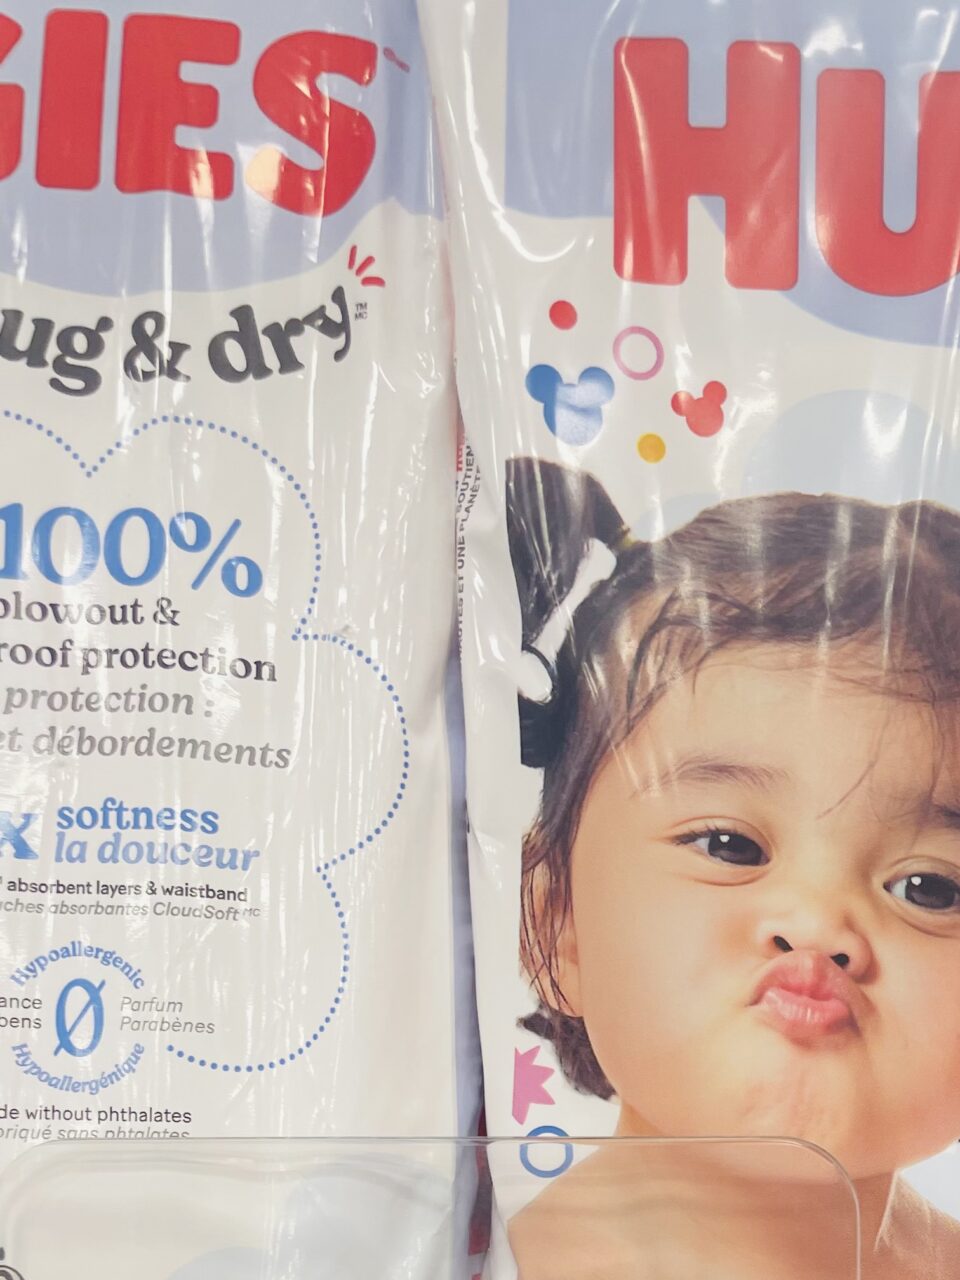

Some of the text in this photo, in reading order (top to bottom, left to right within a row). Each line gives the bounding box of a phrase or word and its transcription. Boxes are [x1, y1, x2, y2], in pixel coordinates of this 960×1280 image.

[124, 286, 351, 383] & dry
[0, 502, 263, 598] 100%
[152, 598, 181, 625] &
[81, 642, 278, 683] protection
[2, 683, 194, 718] protection
[33, 726, 292, 770] débordements
[56, 797, 220, 836] softness
[55, 832, 261, 871] la douceur
[8, 877, 248, 903] absorbent layers & waistband
[49, 900, 149, 918] absorbantes
[10, 941, 145, 989] Hypoallergenic
[120, 996, 183, 1013] Parfum
[120, 1016, 215, 1034] Parabènes
[11, 1043, 145, 1095] Hypoallergénique
[25, 1106, 192, 1124] without phthalates
